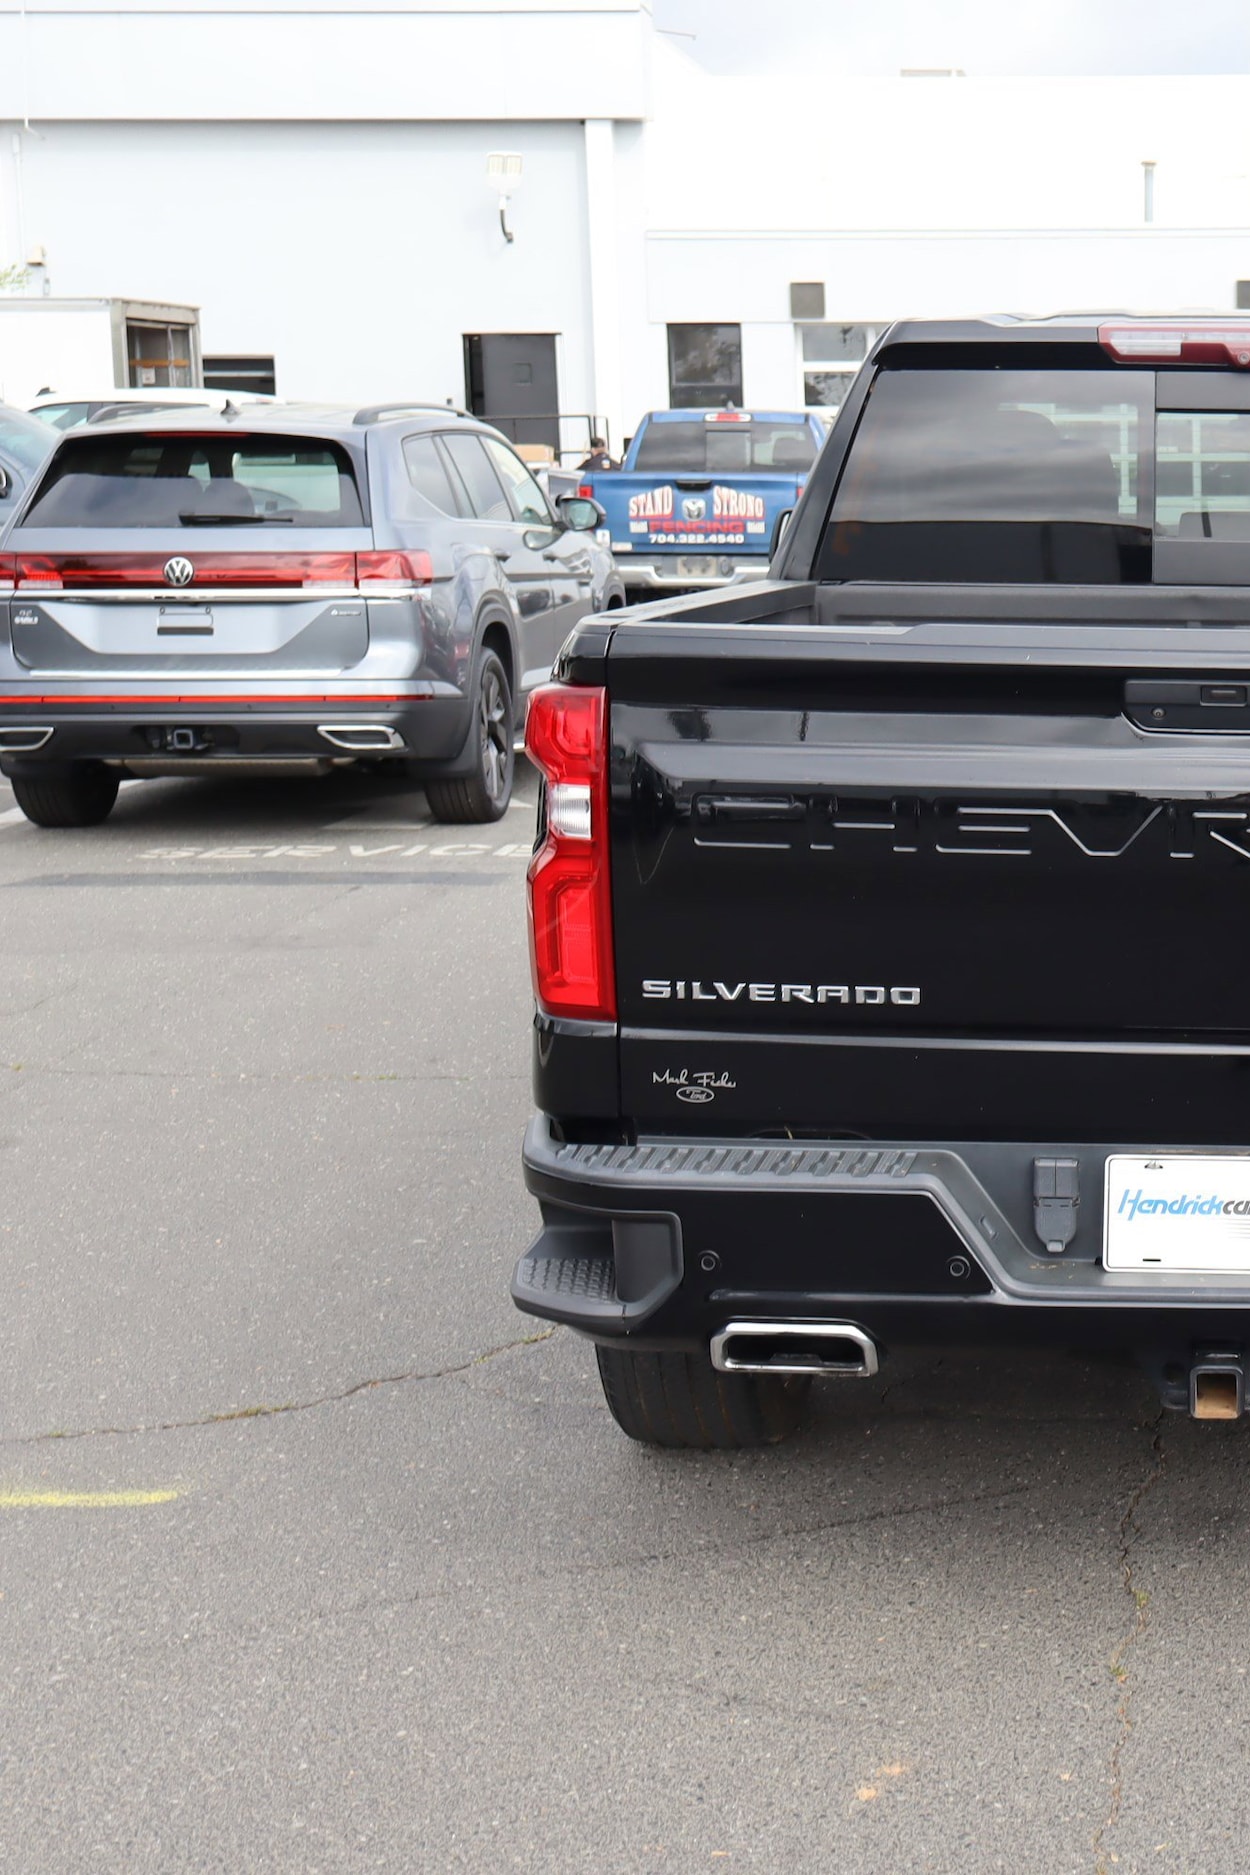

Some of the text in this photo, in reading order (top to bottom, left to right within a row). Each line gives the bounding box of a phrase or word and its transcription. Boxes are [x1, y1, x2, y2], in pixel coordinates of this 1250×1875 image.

[629, 485, 764, 518] STAND STRONG
[649, 521, 745, 533] FENCING
[642, 980, 921, 1006] SILVERADO
